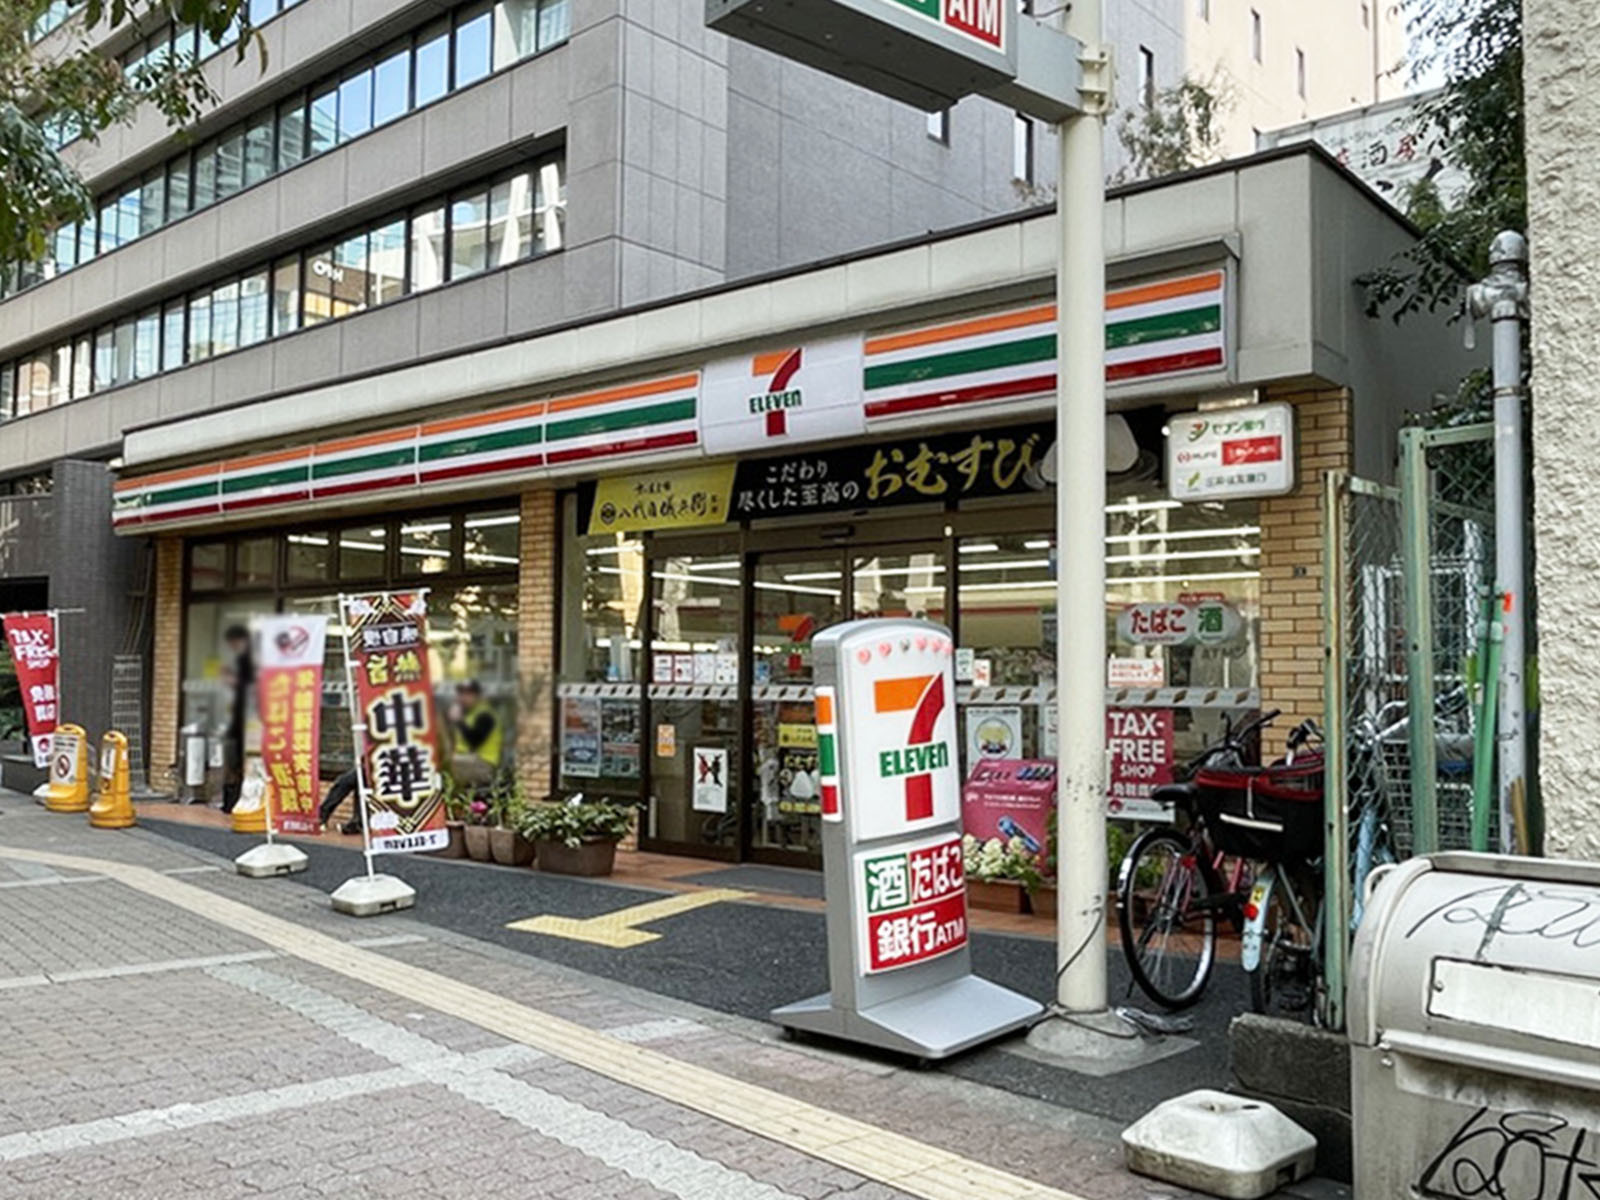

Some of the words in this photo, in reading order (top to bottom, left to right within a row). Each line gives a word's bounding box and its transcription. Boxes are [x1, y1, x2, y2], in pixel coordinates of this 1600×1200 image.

[752, 347, 802, 437] 7
[765, 460, 828, 483] こだわり
[865, 433, 1040, 500] おむすび
[738, 481, 860, 512] 尽くした至高の
[1131, 607, 1187, 634] たばこ
[1198, 606, 1223, 632] 酒
[1108, 712, 1165, 737] TAX-
[874, 671, 945, 822] 7
[1108, 739, 1165, 763] FREE
[1120, 763, 1156, 778] SHOP
[867, 858, 907, 911] 酒
[911, 845, 963, 901] たばこ
